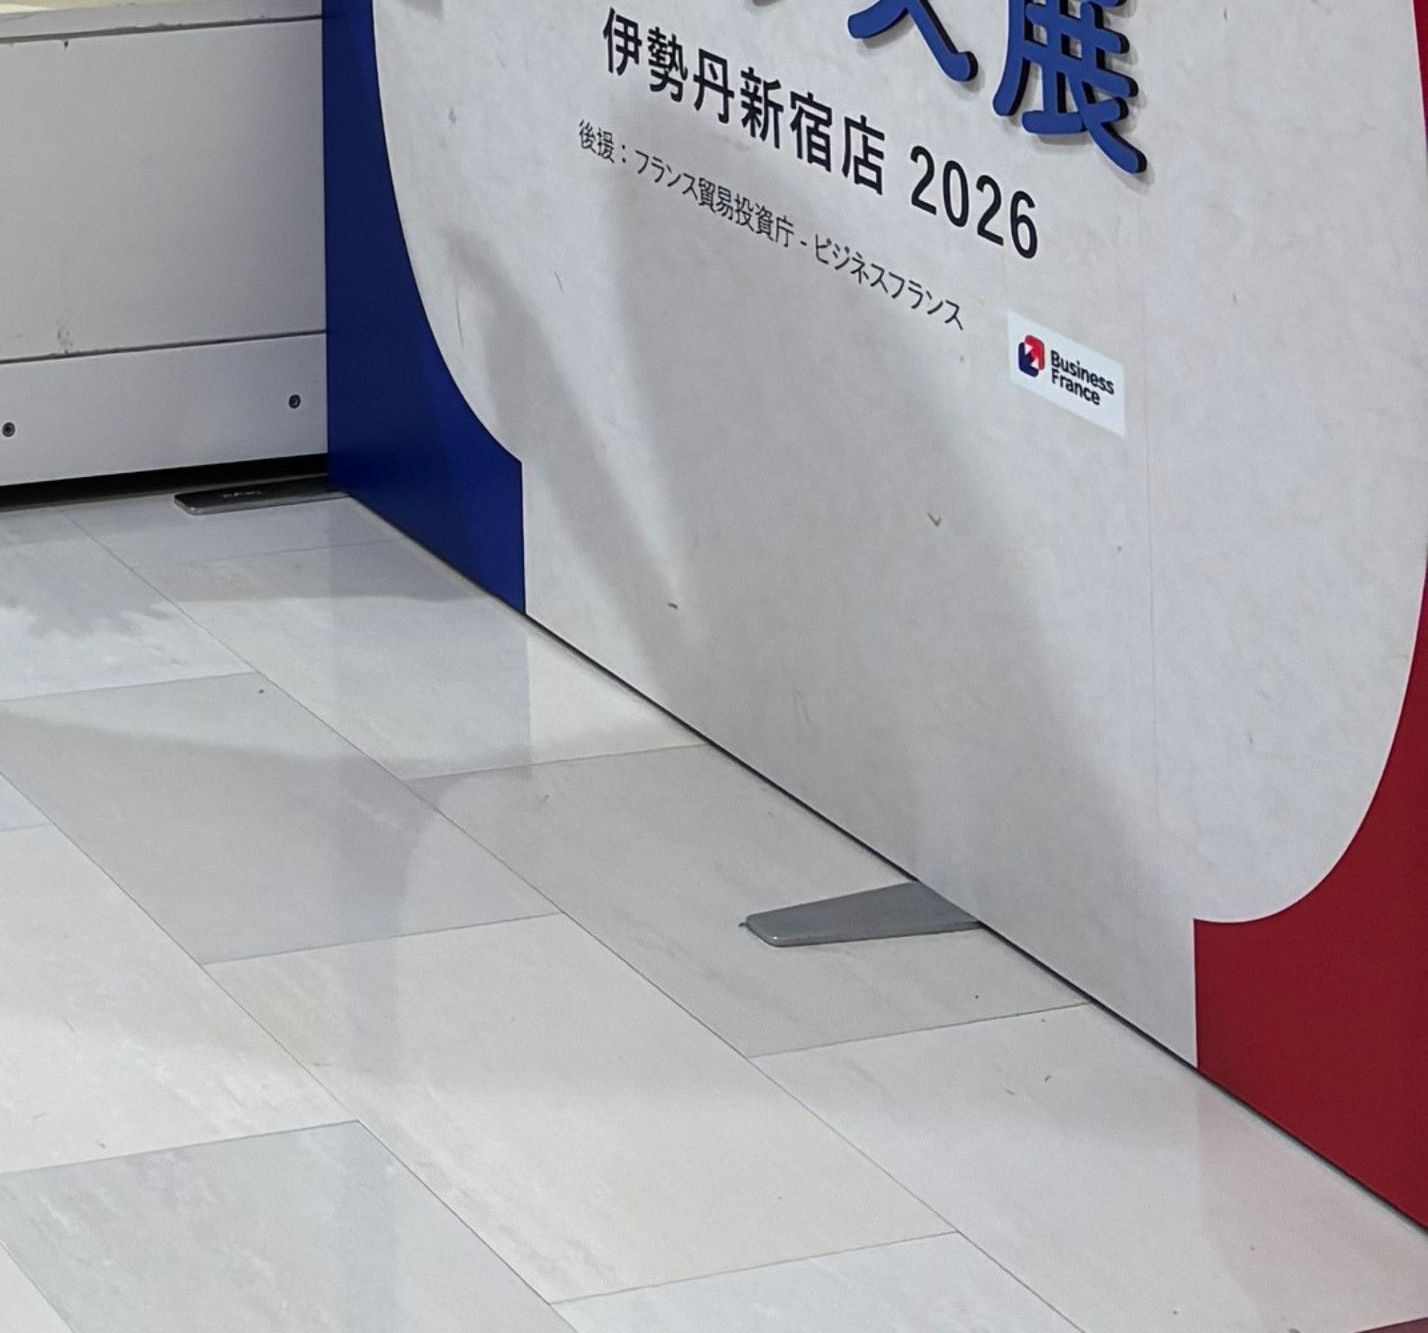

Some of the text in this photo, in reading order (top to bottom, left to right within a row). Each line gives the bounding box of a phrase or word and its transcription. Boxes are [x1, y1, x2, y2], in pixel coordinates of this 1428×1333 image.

[602, 6, 1038, 259] 伊勢丹新宿店 2026
[815, 233, 964, 330] ビジネスフランス
[1050, 349, 1114, 396] Business
[1051, 369, 1101, 407] France
